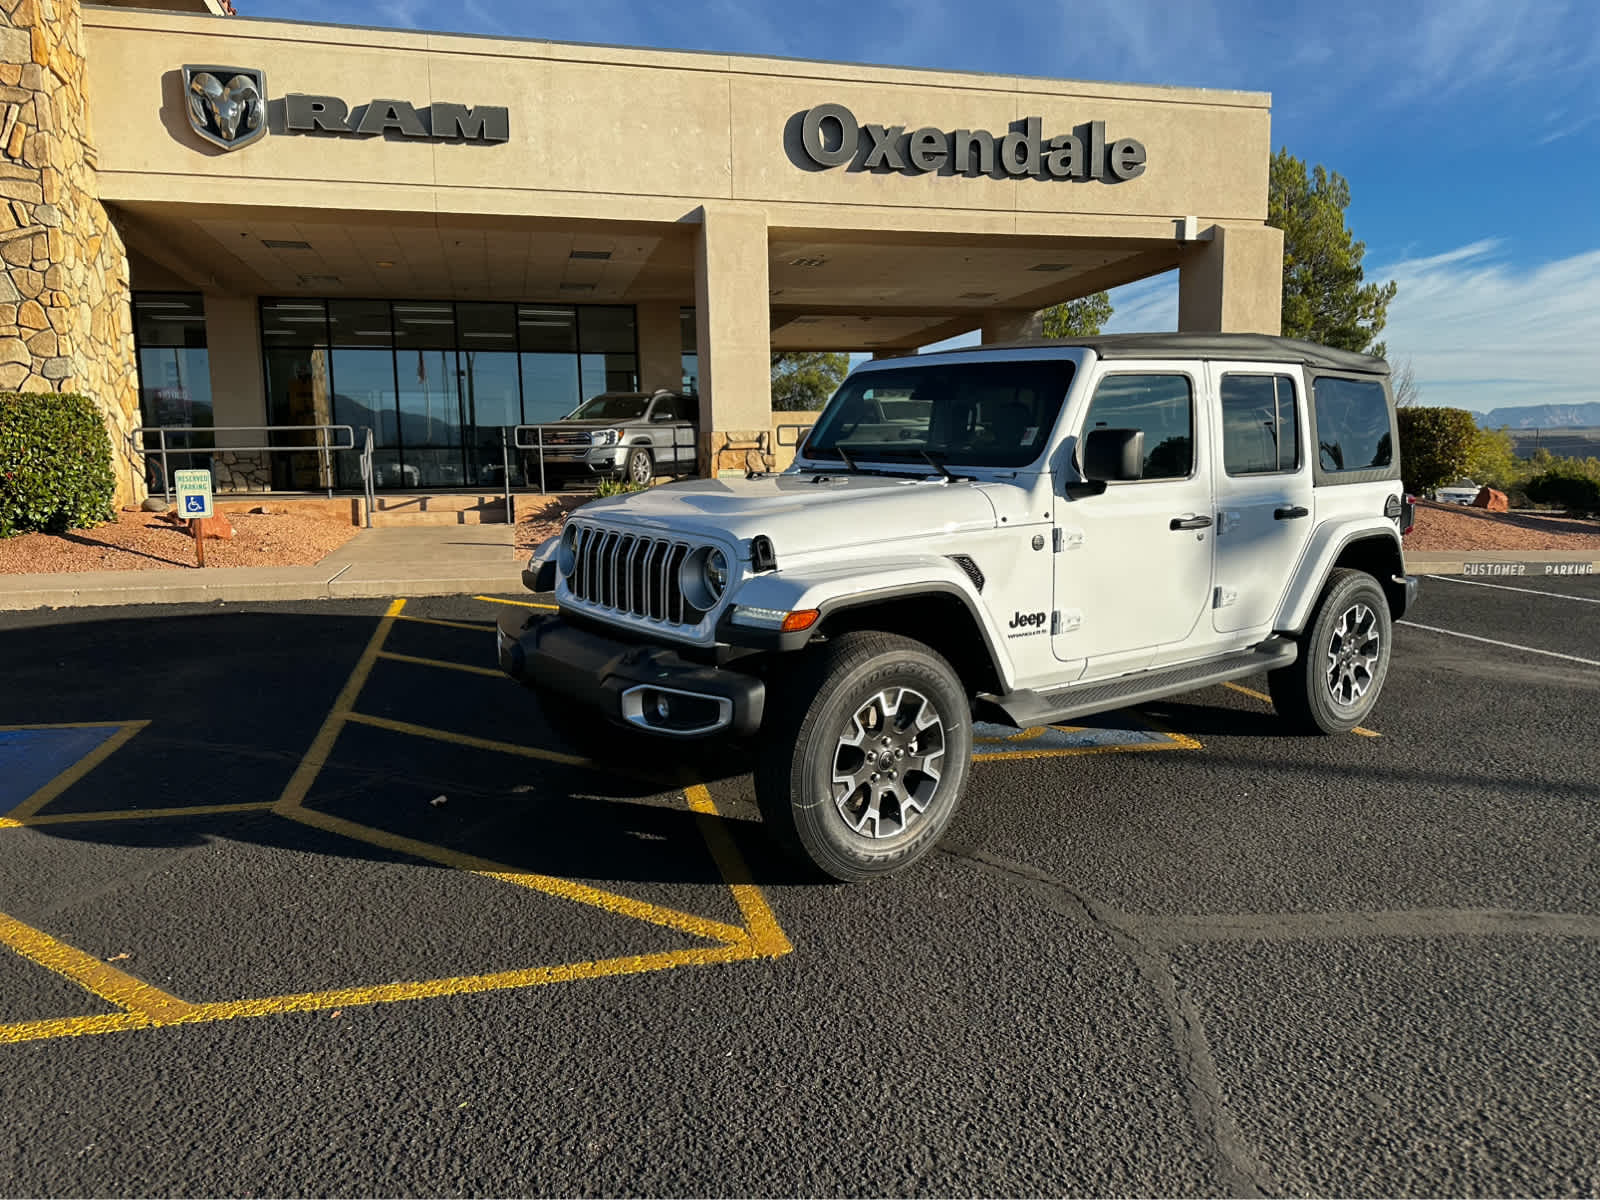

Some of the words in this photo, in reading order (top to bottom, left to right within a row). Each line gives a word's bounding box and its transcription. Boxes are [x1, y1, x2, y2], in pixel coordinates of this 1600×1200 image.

[286, 93, 509, 142] RAM
[801, 102, 1147, 181] Oxendale
[177, 474, 208, 482] RESERVED
[1464, 563, 1526, 576] CUSTOMER
[1545, 564, 1592, 575] PARKING
[1009, 611, 1046, 628] Jeep
